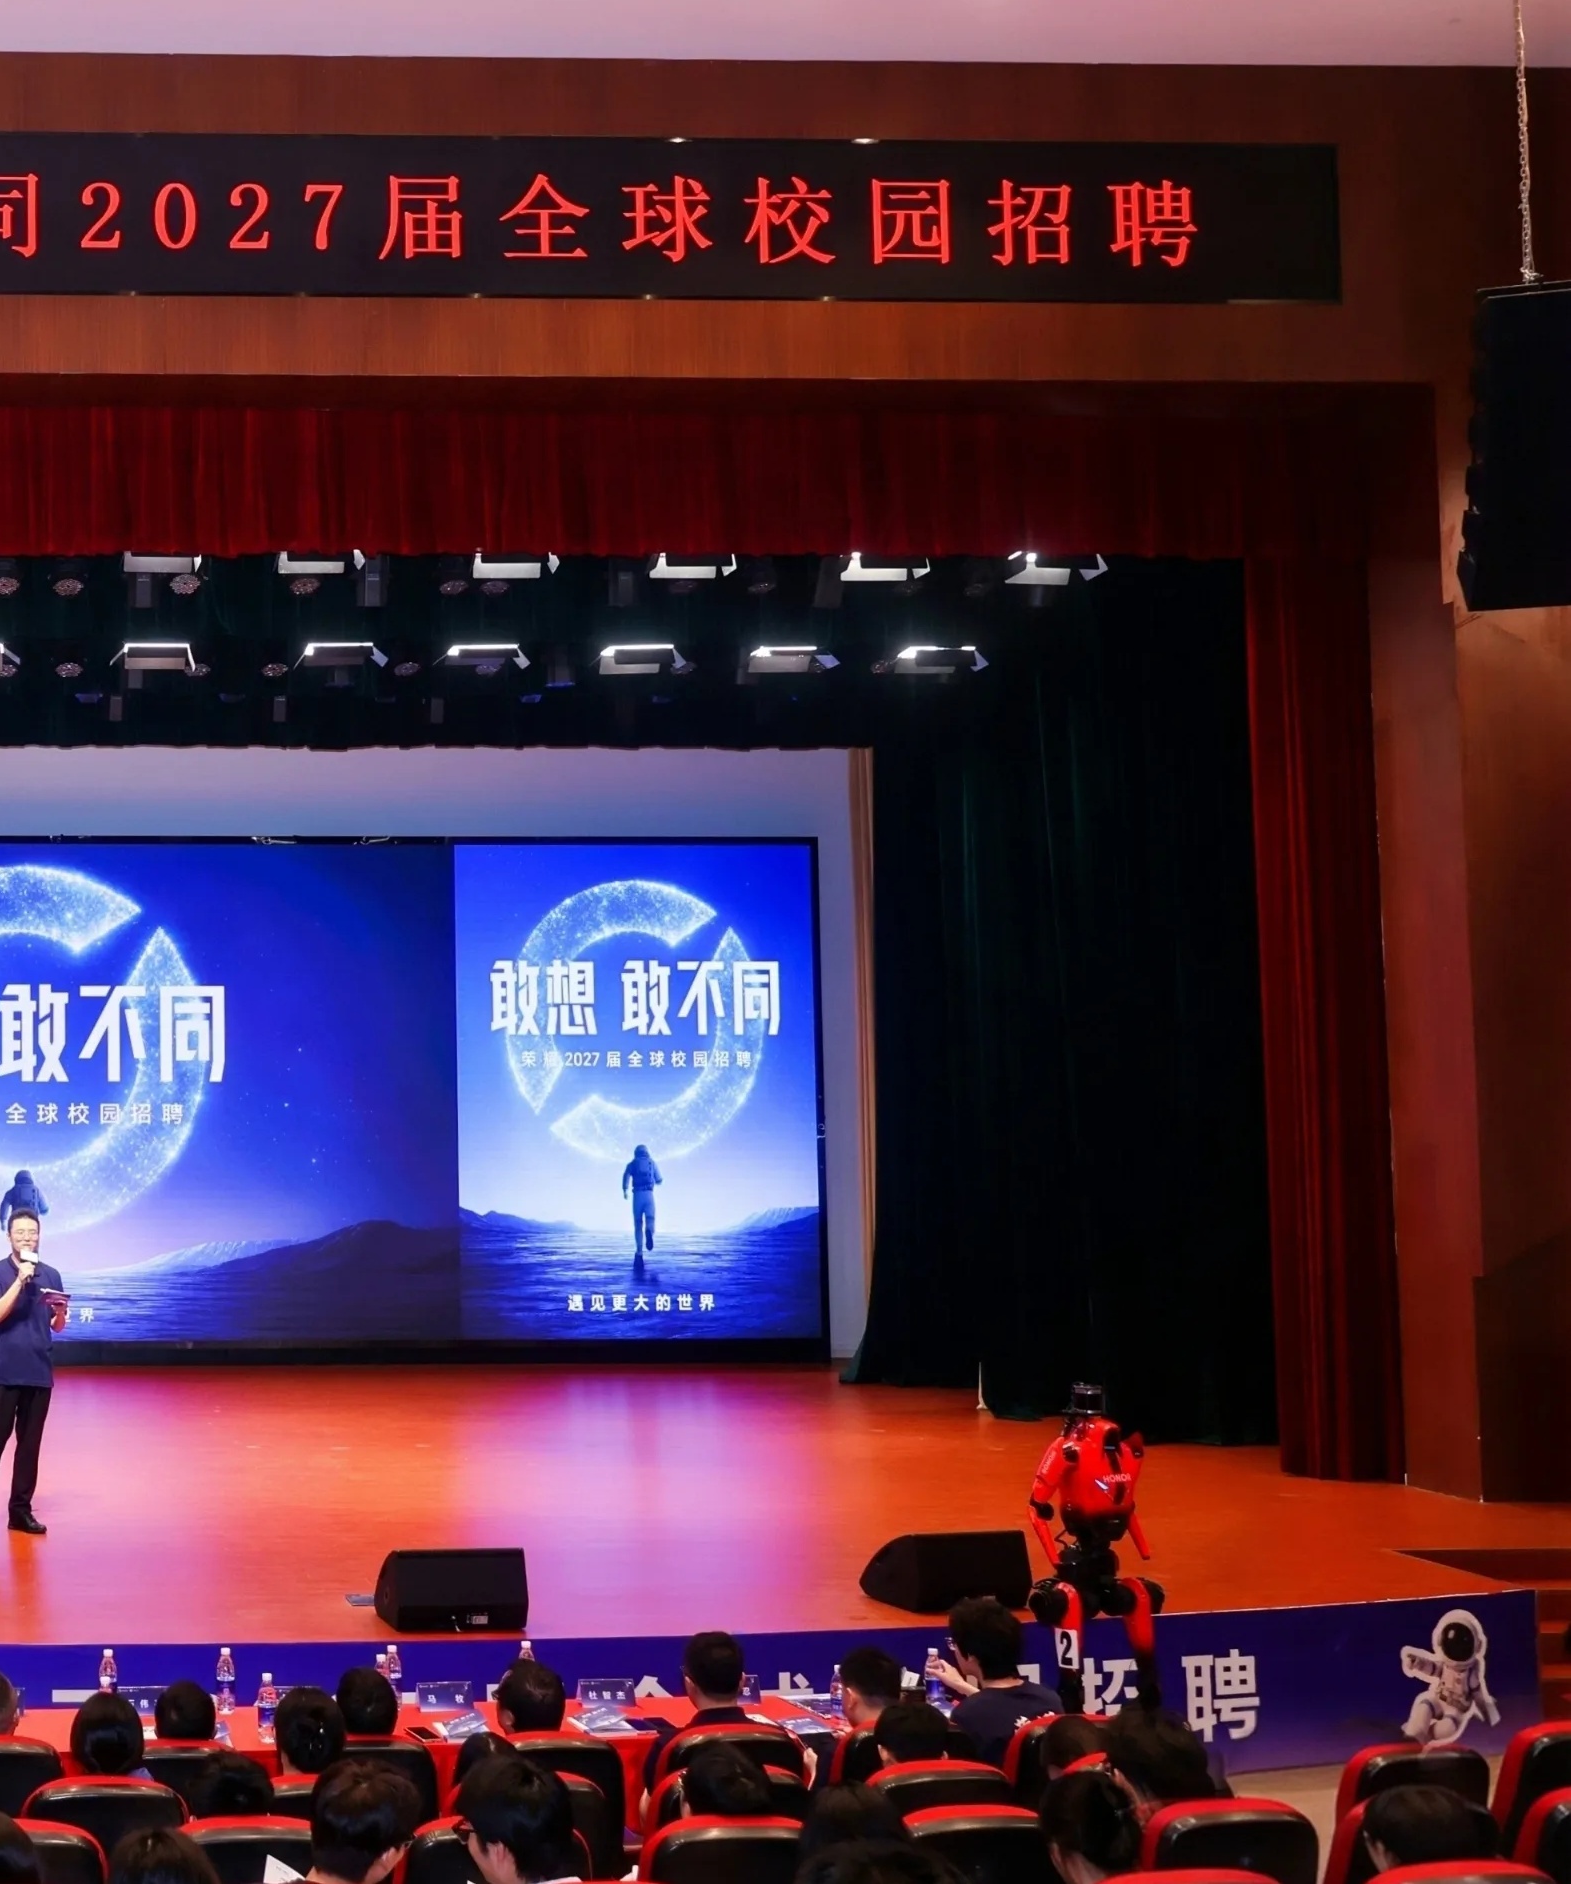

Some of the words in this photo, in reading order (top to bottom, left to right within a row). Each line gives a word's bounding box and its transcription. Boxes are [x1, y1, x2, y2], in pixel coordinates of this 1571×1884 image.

[490, 960, 597, 1036] 敢想
[621, 960, 780, 1036] 敢不同
[567, 1294, 715, 1311] 遇见更大的世界
[1059, 1630, 1073, 1667] 2
